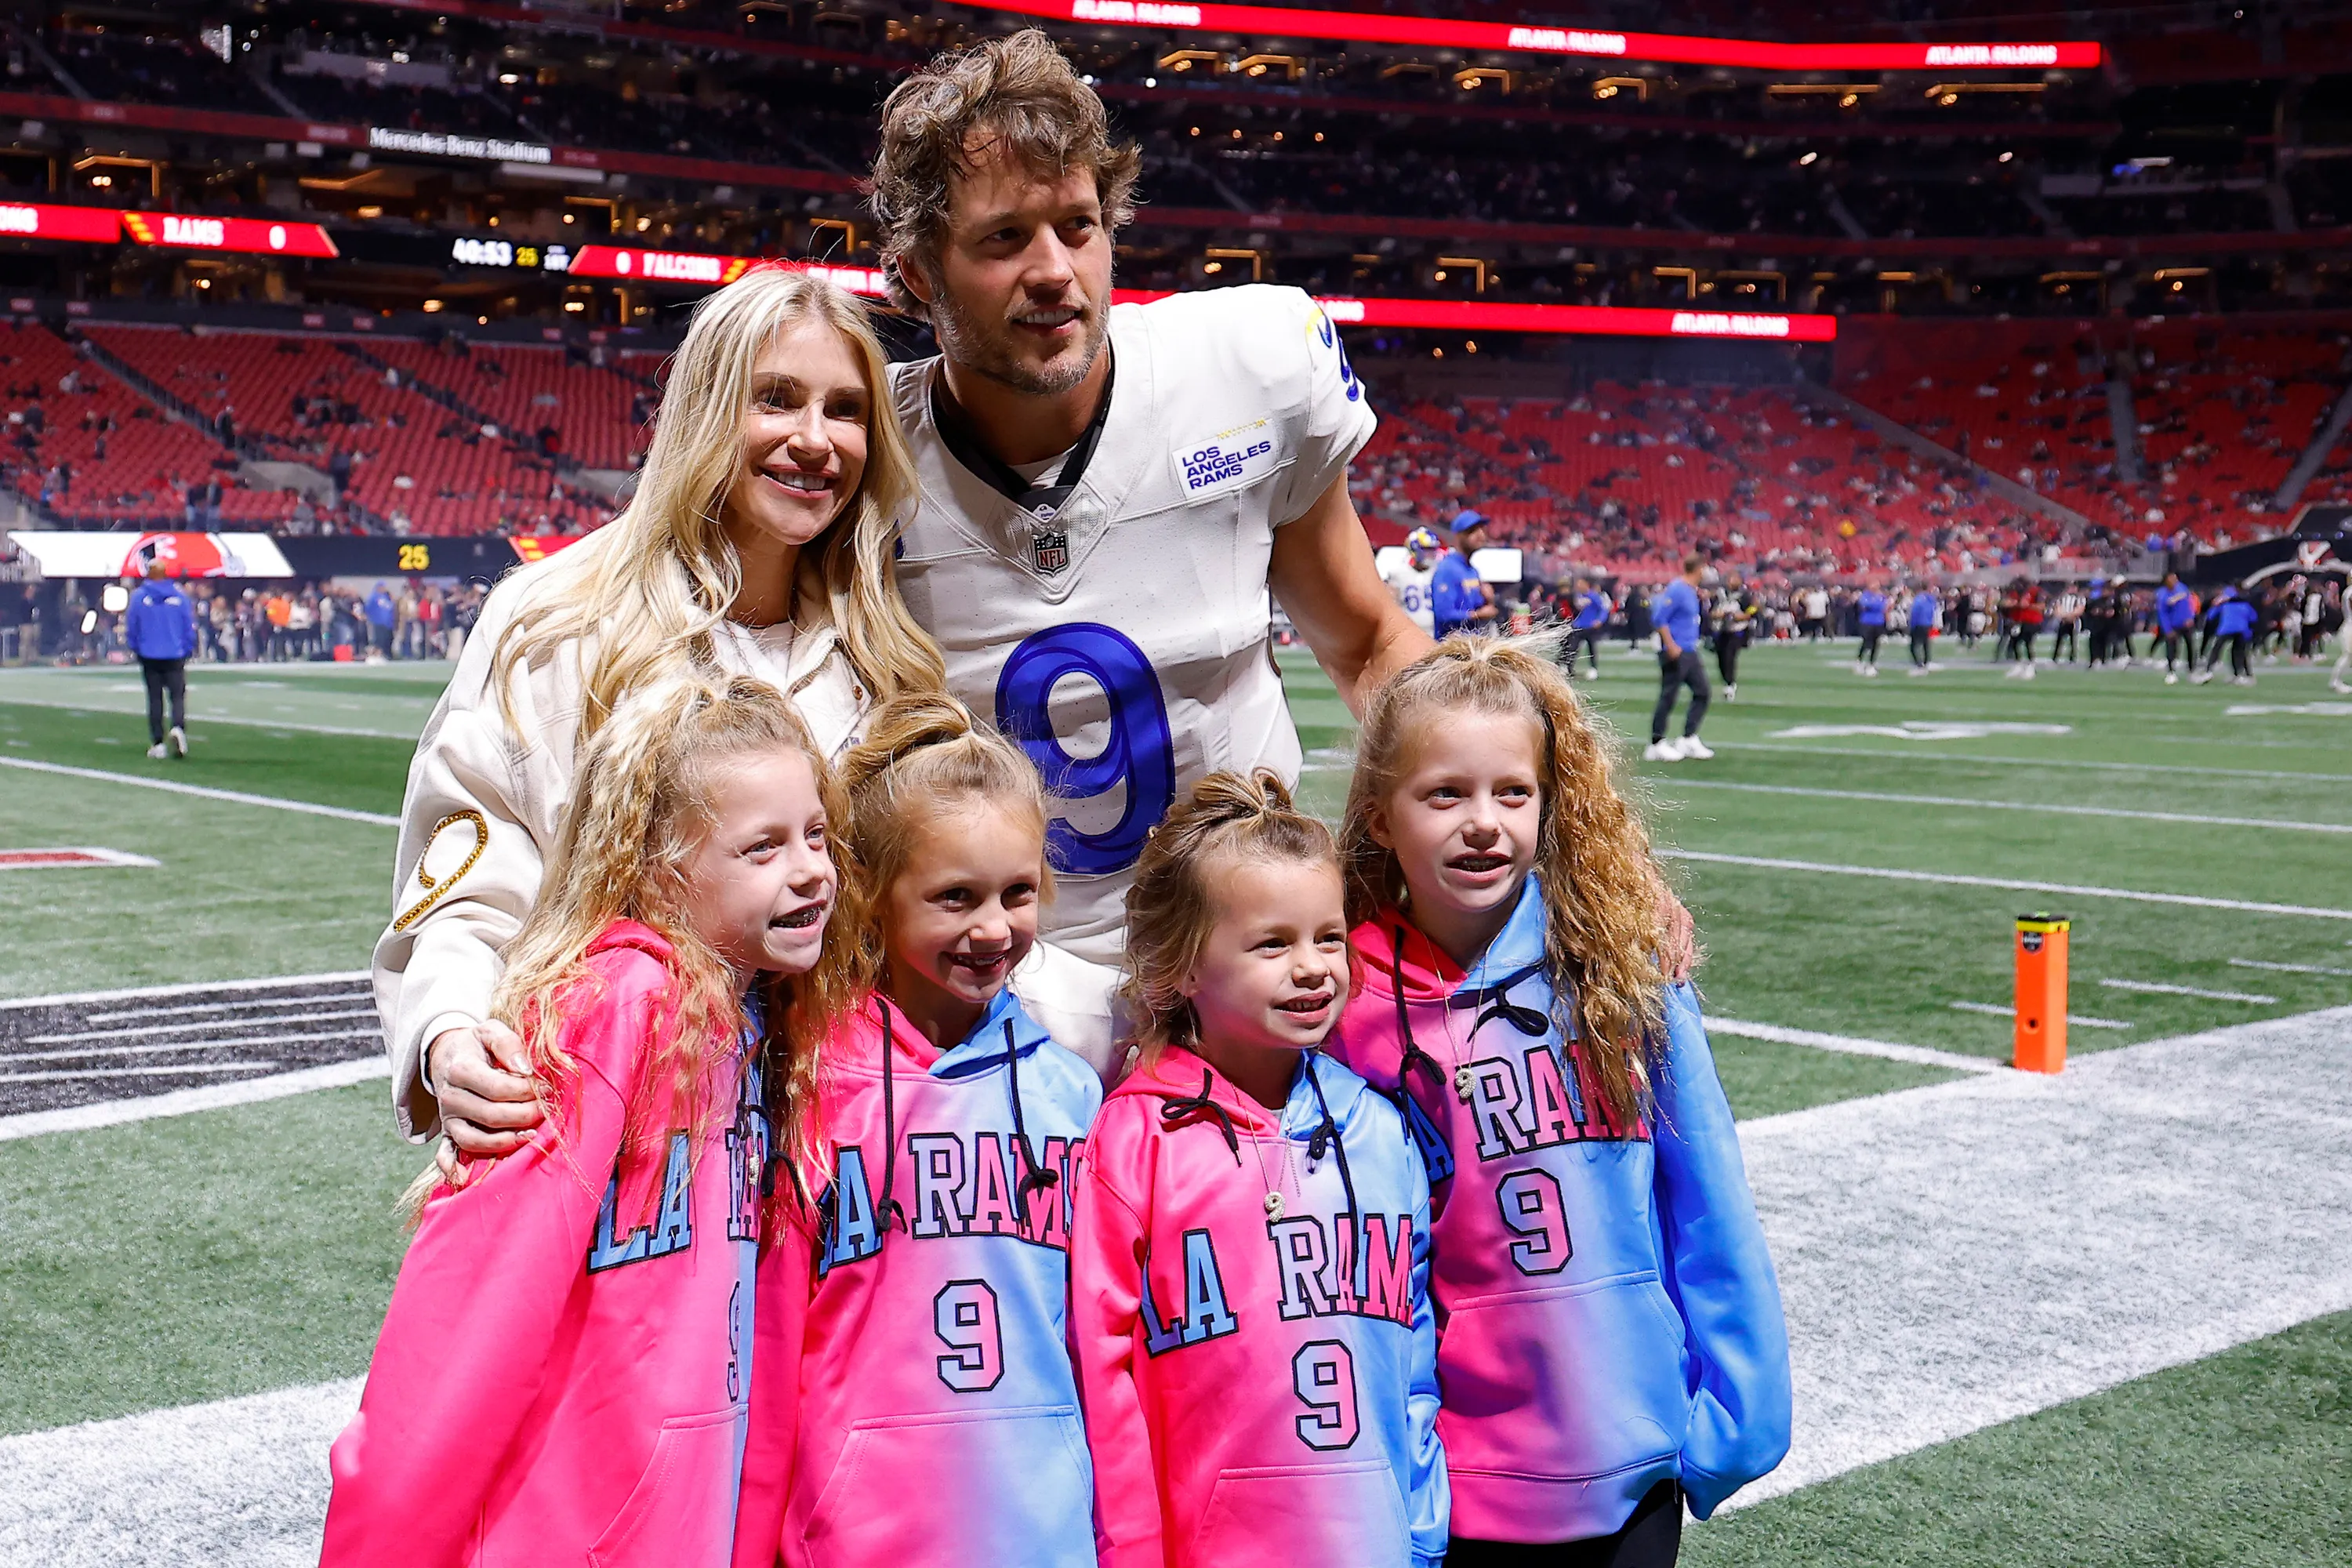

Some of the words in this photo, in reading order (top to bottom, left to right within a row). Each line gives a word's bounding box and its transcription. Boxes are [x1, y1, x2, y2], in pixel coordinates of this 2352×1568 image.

[1136, 3, 1201, 27] FALCONS
[1508, 27, 1567, 50] ATLANTA
[1568, 31, 1626, 55] FALCONS
[1925, 45, 1991, 65] ATLANTA
[1991, 45, 2058, 64] FALCONS
[370, 127, 486, 158] Mercedes-Benz
[486, 138, 551, 164] Stadium
[162, 216, 224, 246] RAMS
[642, 252, 721, 281] FALCONS
[1671, 312, 1730, 335] ATLANTA
[1730, 314, 1790, 337] FALCONS
[1182, 446, 1220, 467] LOS
[1187, 441, 1271, 479] ANGELES
[1189, 464, 1243, 490] RAMS
[398, 543, 430, 571] 25
[1039, 549, 1065, 568] NFL
[995, 622, 1176, 875] 9
[1496, 1167, 1573, 1276] 9
[934, 1279, 1004, 1393] 9
[1292, 1339, 1359, 1451] 9
